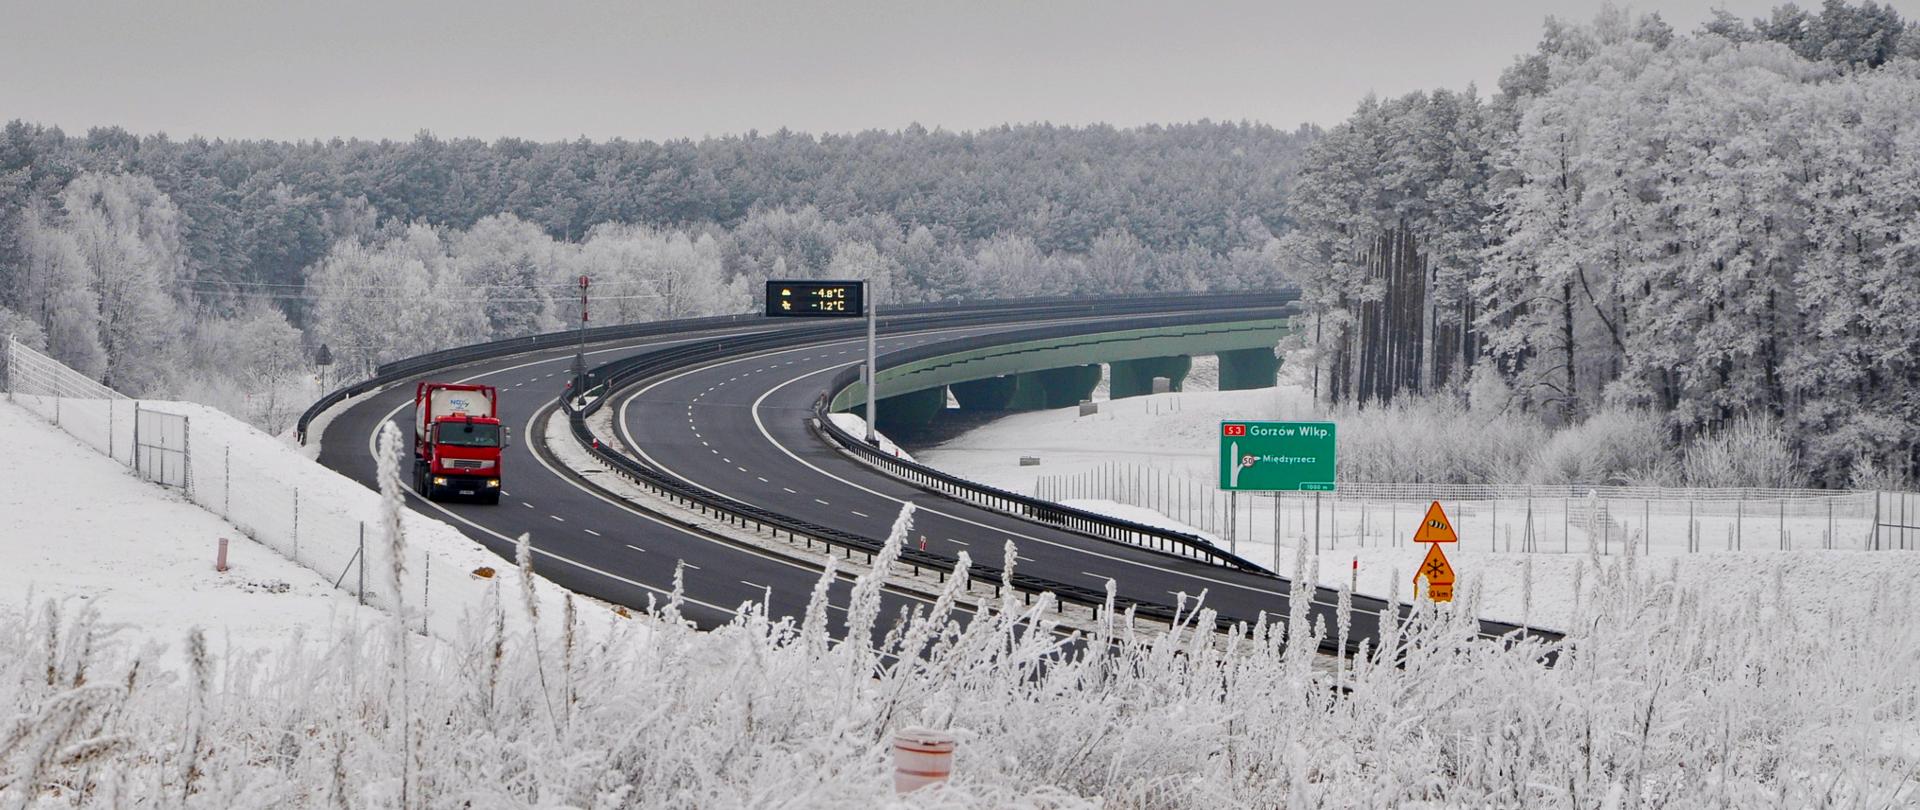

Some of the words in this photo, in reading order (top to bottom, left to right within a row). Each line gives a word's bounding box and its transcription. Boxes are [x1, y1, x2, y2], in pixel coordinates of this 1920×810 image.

[811, 288, 845, 298] -4.8°C
[811, 301, 845, 310] -1.2°C
[1250, 425, 1295, 436] Gorzów
[1299, 426, 1332, 439] Wlkp.
[1262, 454, 1316, 464] Międzyrzecz
